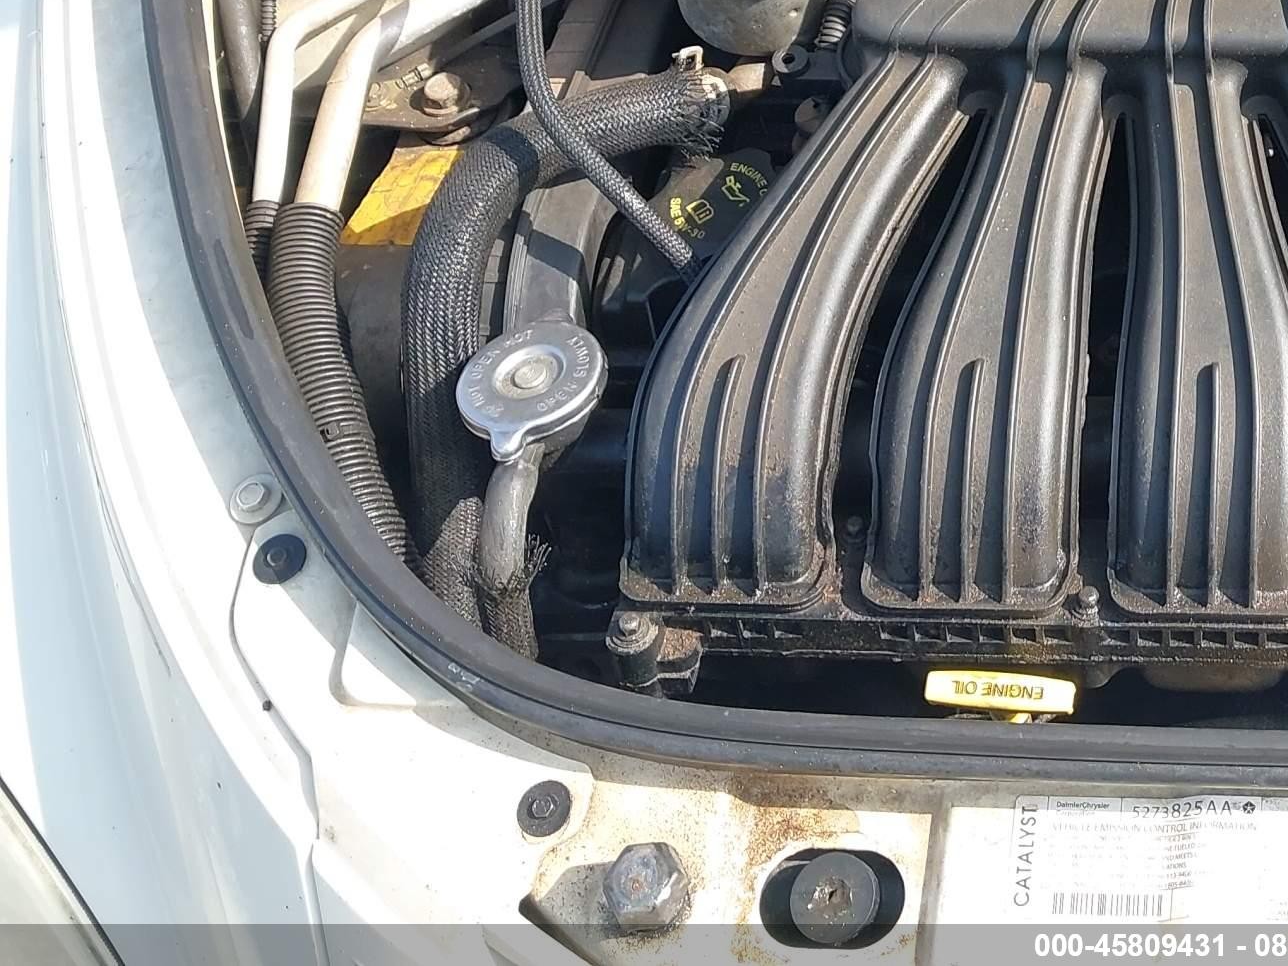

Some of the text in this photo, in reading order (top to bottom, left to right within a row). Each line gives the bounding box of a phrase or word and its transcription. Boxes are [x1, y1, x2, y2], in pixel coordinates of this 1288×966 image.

[730, 162, 769, 188] ENGINE
[670, 197, 682, 219] SAE
[471, 349, 501, 380] OPEN
[952, 680, 1044, 700] ENGINE OIL
[1056, 801, 1110, 810] DaimlerChrysler
[1132, 799, 1232, 819] 5273825AA
[1013, 803, 1039, 907] CATALYST
